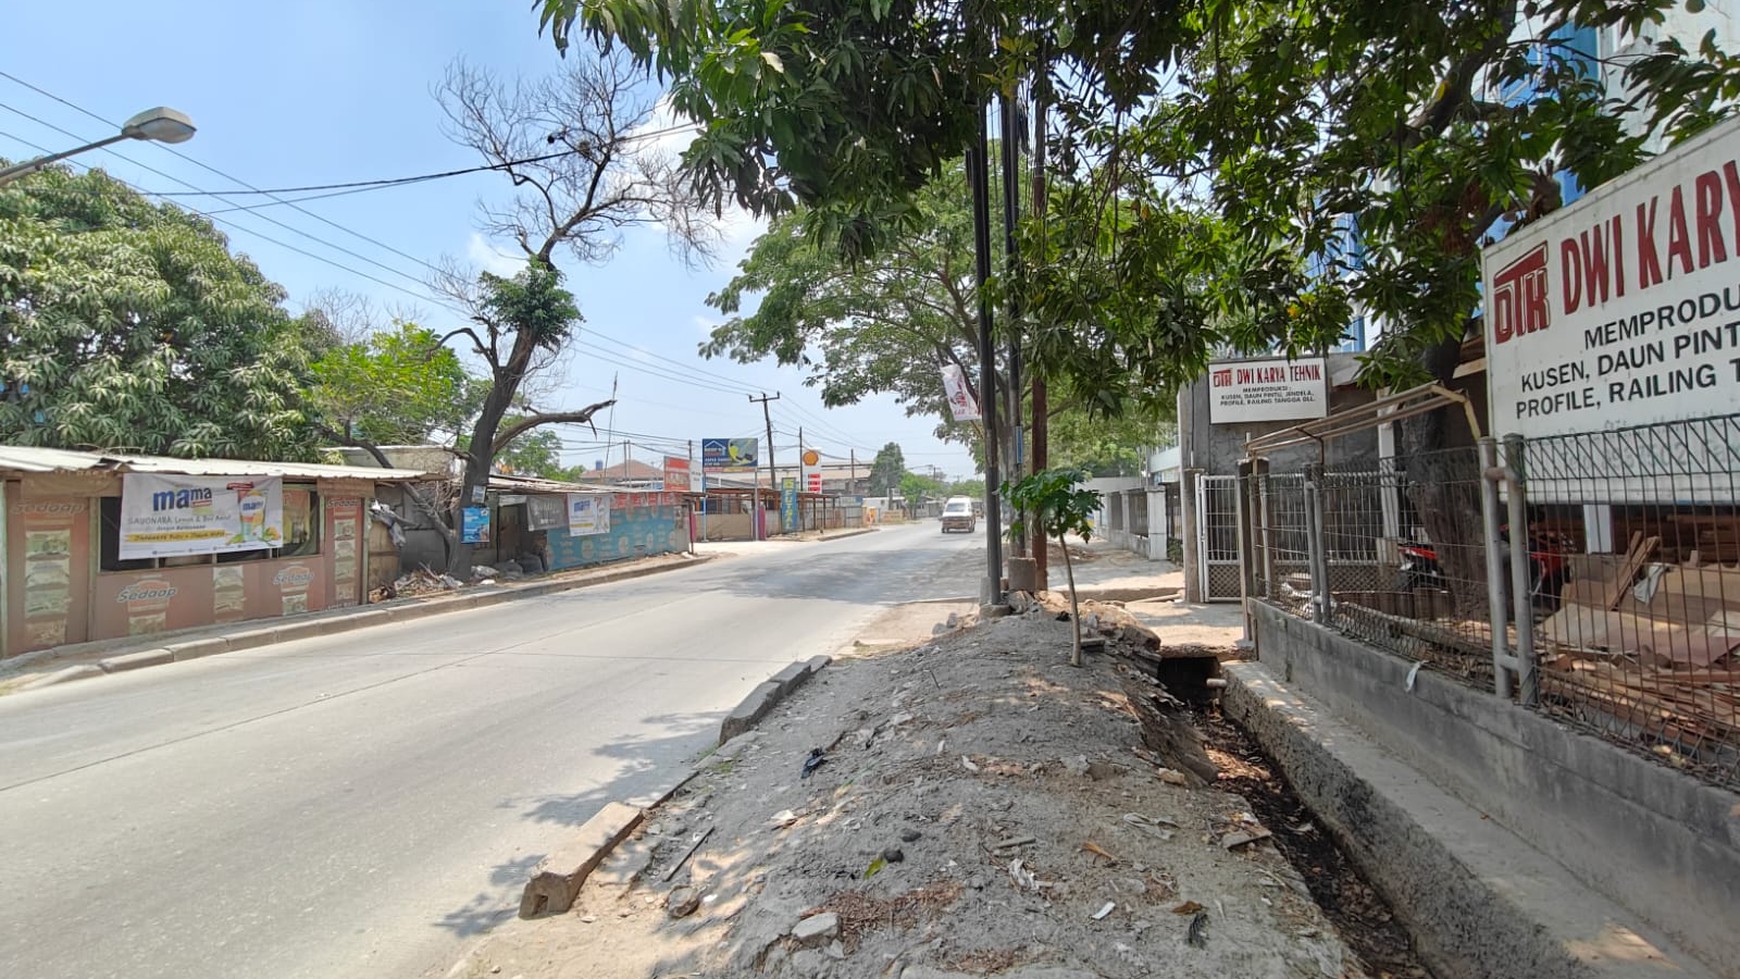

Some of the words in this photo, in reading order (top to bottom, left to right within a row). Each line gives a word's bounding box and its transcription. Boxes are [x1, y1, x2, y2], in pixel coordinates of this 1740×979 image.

[1560, 214, 1625, 316] DWI
[1584, 284, 1740, 350] MEMPRODU
[1237, 369, 1254, 385] DWI
[1257, 366, 1286, 384] KARYA
[1290, 364, 1321, 382] TEHNIK
[1521, 361, 1590, 393] KUSEN,
[1597, 340, 1664, 377] DAUN
[1674, 321, 1740, 359] PINT
[1516, 388, 1601, 419] PROFILE,
[1609, 364, 1716, 404] RAILING
[153, 487, 212, 512] mama
[117, 588, 177, 603] Sedaap
